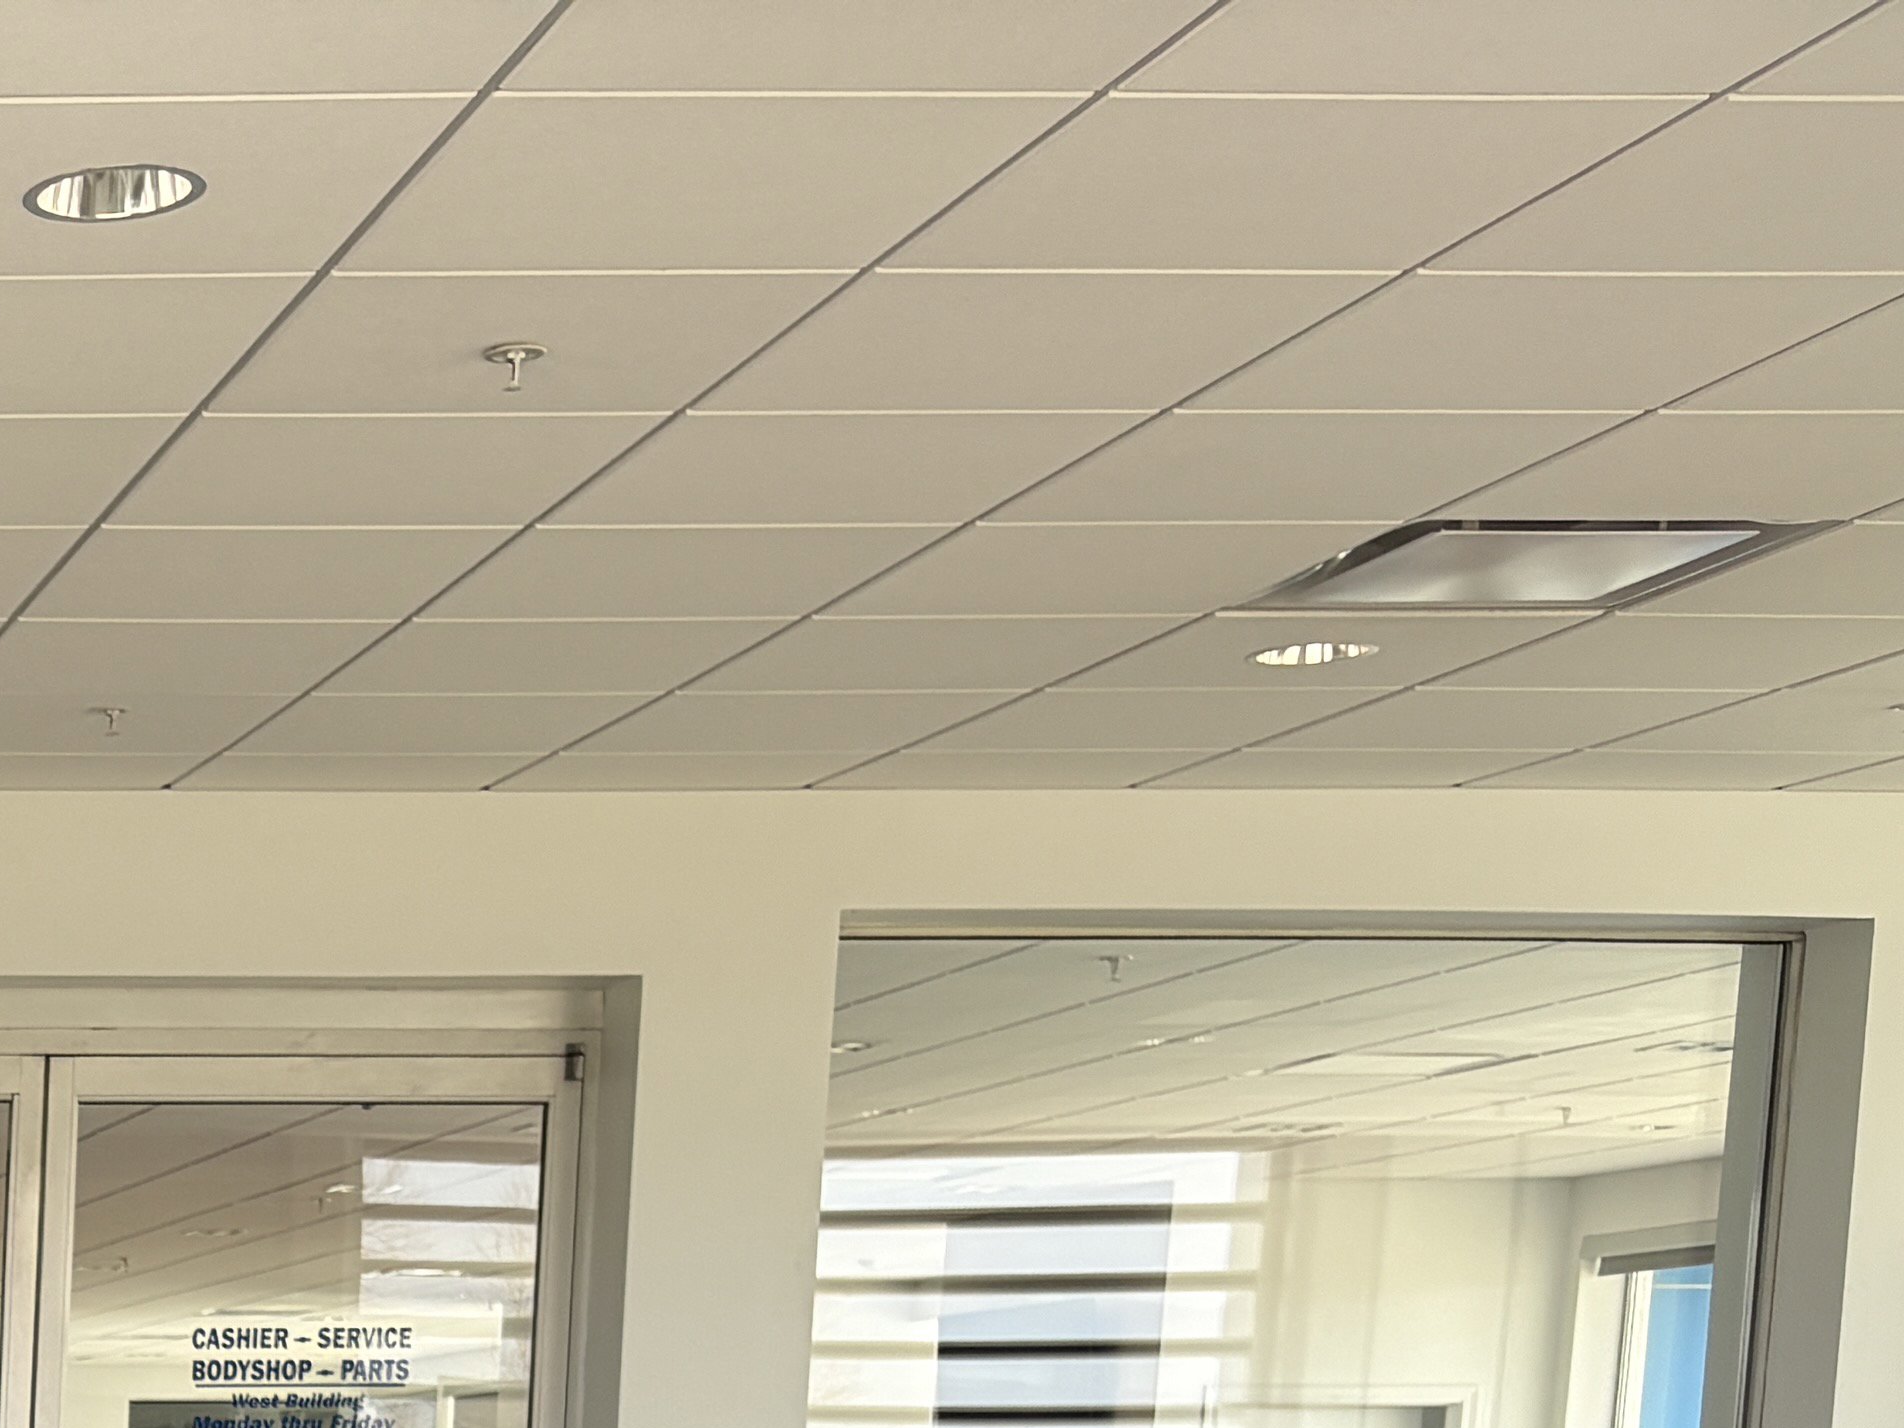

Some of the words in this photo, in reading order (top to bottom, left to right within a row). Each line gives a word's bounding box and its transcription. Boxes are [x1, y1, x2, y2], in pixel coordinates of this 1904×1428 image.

[192, 1328, 288, 1349] CASHIER
[317, 1328, 412, 1348] SERVICE
[192, 1360, 312, 1381] BODYSHOP
[341, 1360, 409, 1381] PARTS
[232, 1393, 279, 1409] West
[285, 1393, 365, 1411] Building
